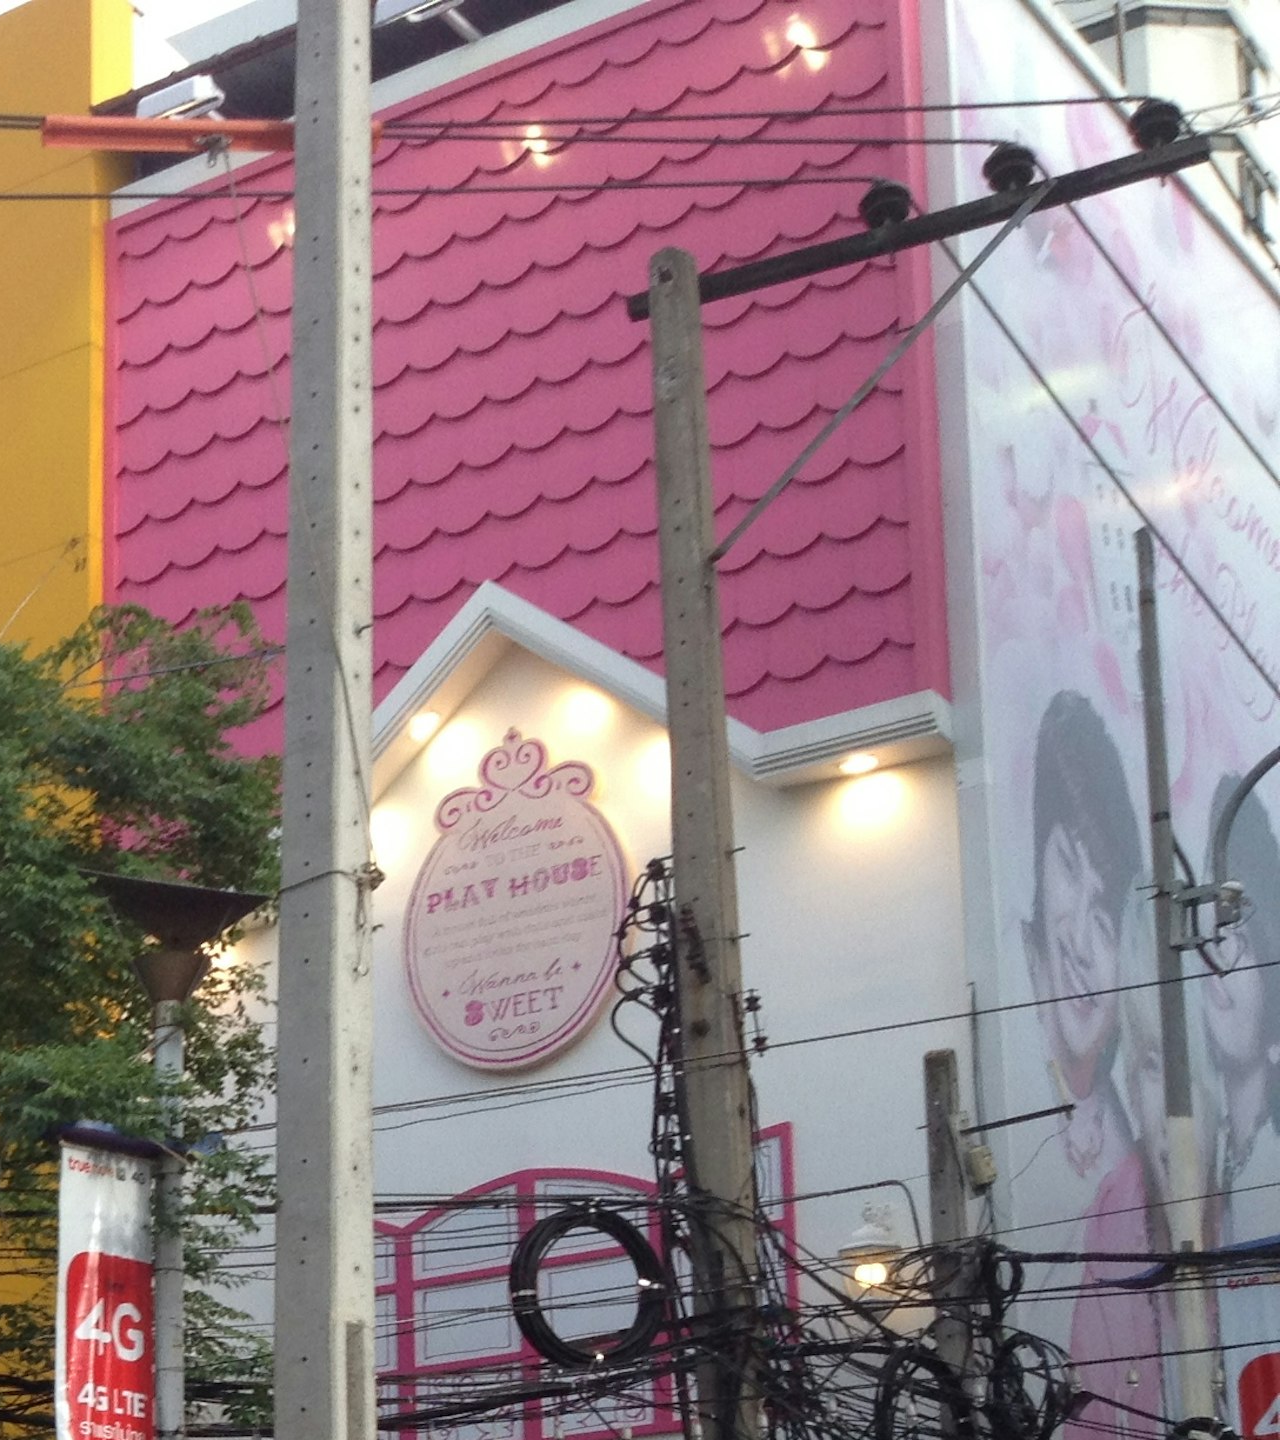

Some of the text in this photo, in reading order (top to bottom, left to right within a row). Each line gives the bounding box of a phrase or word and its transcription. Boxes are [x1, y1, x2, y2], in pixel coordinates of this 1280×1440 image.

[459, 815, 563, 851] Welcome
[507, 854, 602, 899] HOUSE
[463, 985, 564, 1028] SWEET
[74, 1298, 146, 1362] 4G
[77, 1381, 147, 1419] 4G LTE
